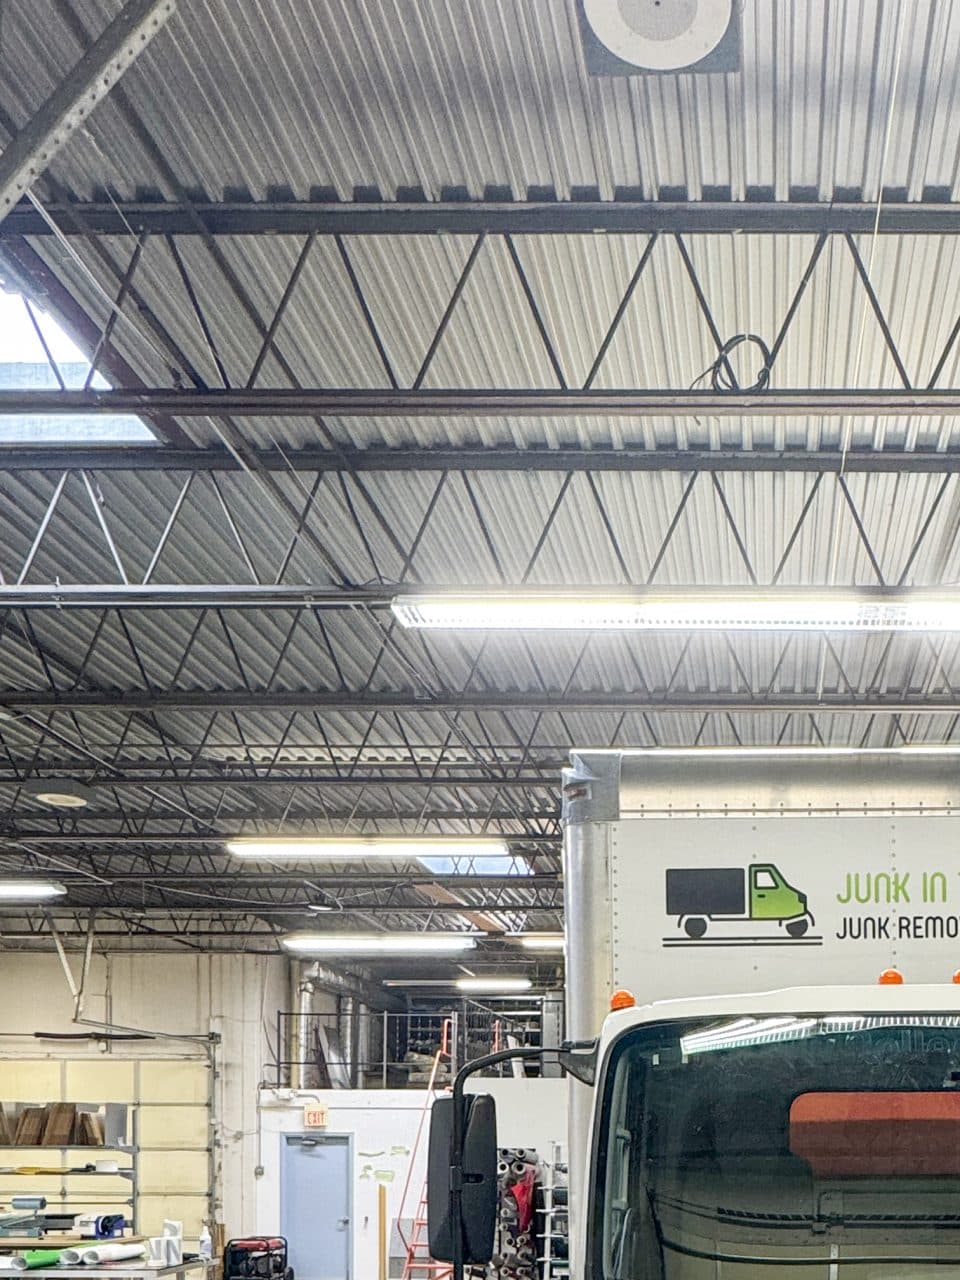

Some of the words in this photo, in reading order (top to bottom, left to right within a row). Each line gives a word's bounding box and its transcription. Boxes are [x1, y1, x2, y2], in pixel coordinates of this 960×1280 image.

[836, 872, 910, 904] JUNK
[922, 871, 947, 903] IN
[836, 916, 890, 939] JUNK
[307, 1111, 325, 1125] EXIT
